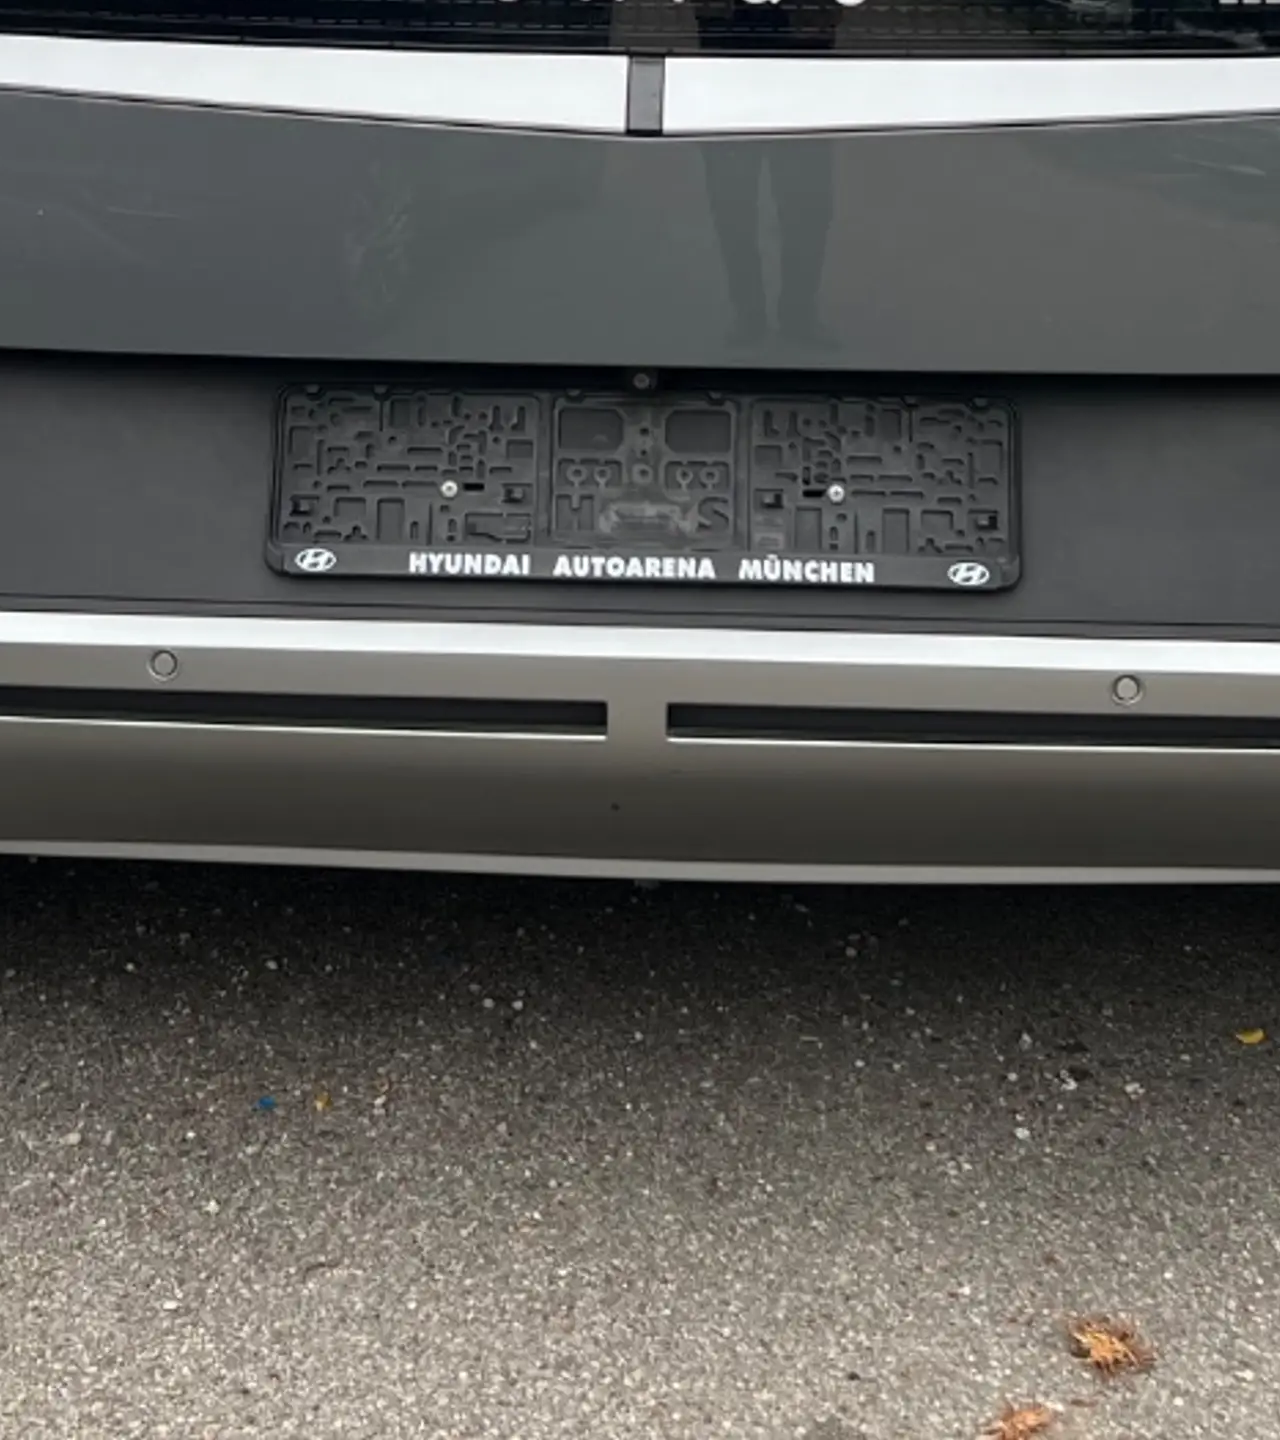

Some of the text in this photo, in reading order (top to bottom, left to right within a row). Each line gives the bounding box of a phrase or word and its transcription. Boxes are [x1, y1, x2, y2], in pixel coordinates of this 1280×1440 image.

[408, 551, 876, 585] HYUNDAI AUTOARENA MÜNCHEN
